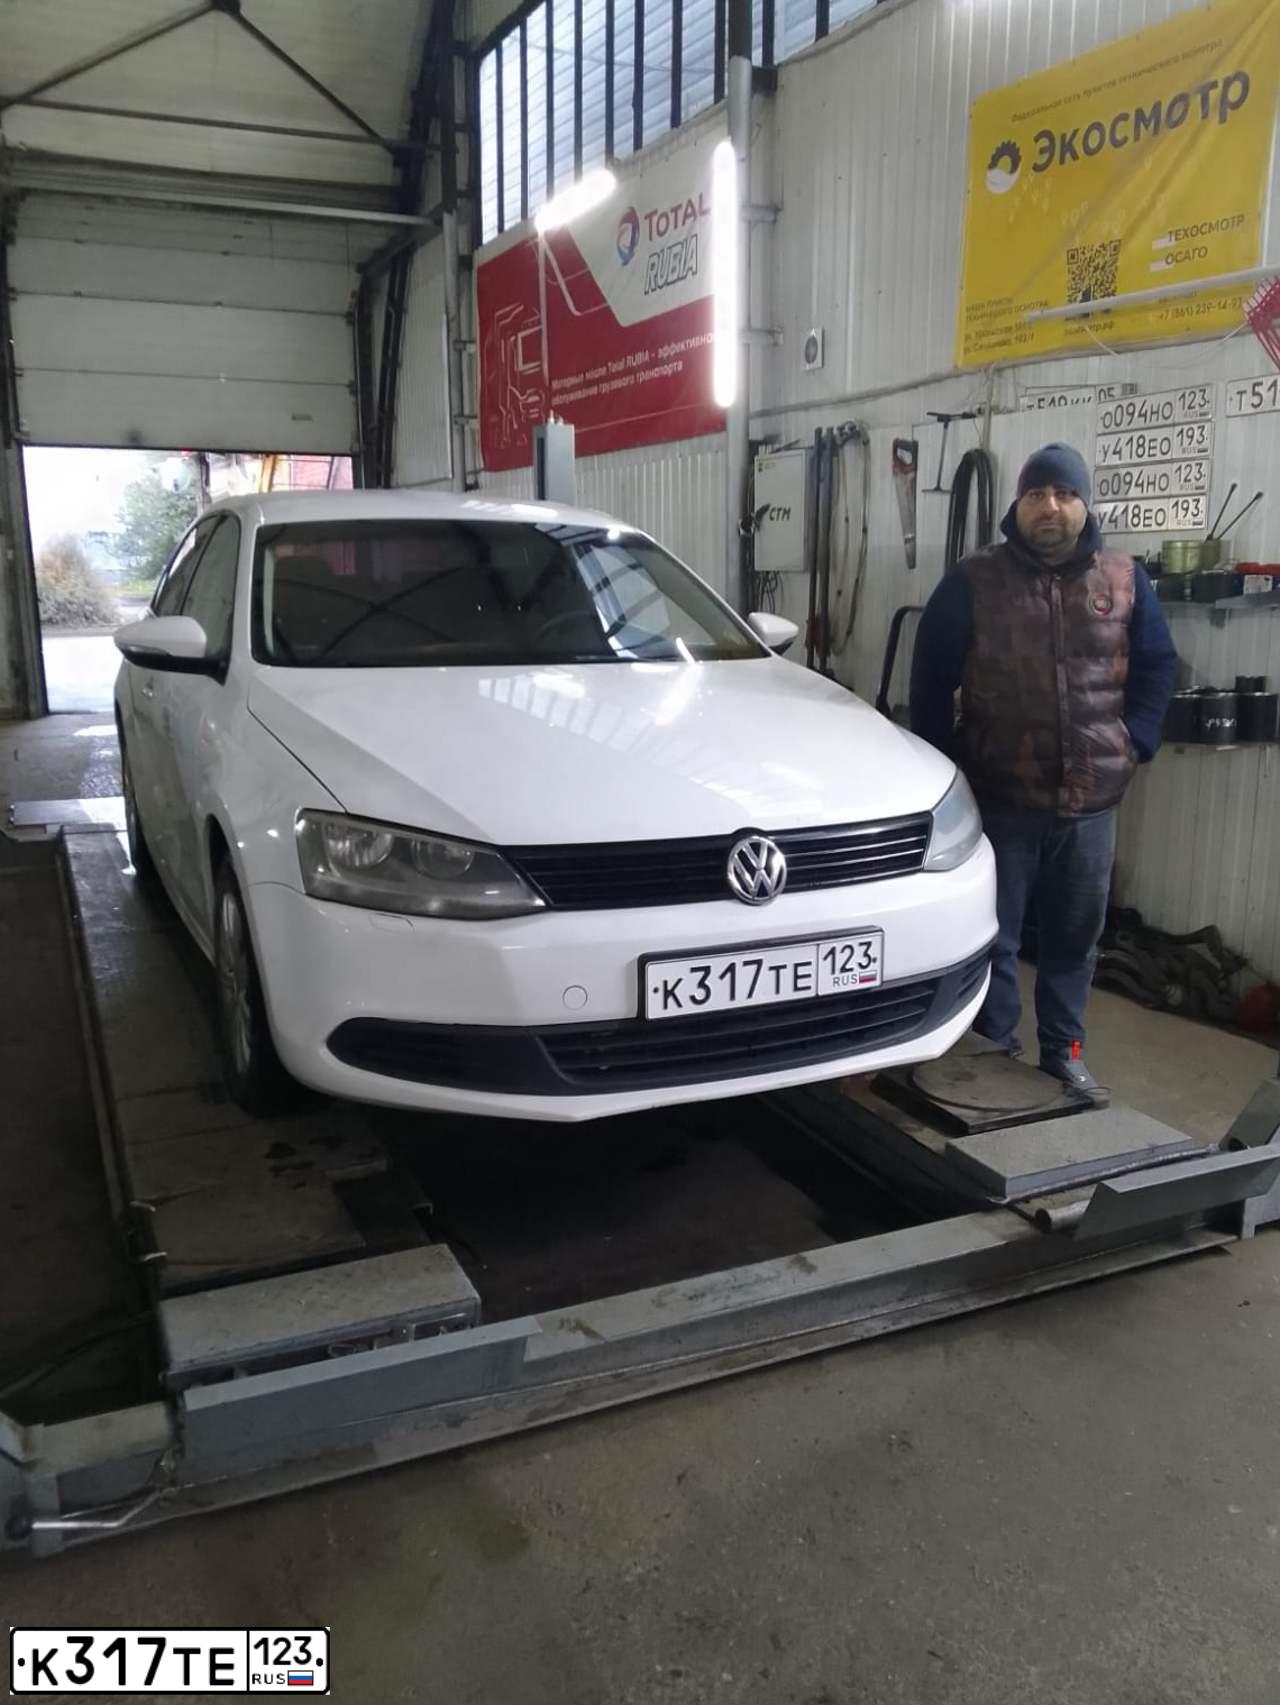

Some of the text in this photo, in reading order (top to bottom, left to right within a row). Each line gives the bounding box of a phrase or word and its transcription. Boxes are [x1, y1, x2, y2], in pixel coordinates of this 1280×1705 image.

[1031, 70, 1251, 173] ЭКОСМОТР
[644, 193, 711, 242] TOTAL
[1168, 213, 1245, 242] ТЕХОСМОТР
[644, 233, 699, 295] RUBIA
[1165, 245, 1208, 265] ОСАГО
[626, 349, 650, 368] RUBIA
[657, 332, 714, 359] эффективно
[1178, 388, 1208, 411] 123
[1236, 378, 1279, 411] Т51
[1101, 425, 1206, 463] У418ЕО 193
[1175, 462, 1204, 483] 123
[1171, 497, 1202, 519] 193
[662, 940, 874, 1010] К317ТЕ 123
[832, 974, 858, 988] RUS
